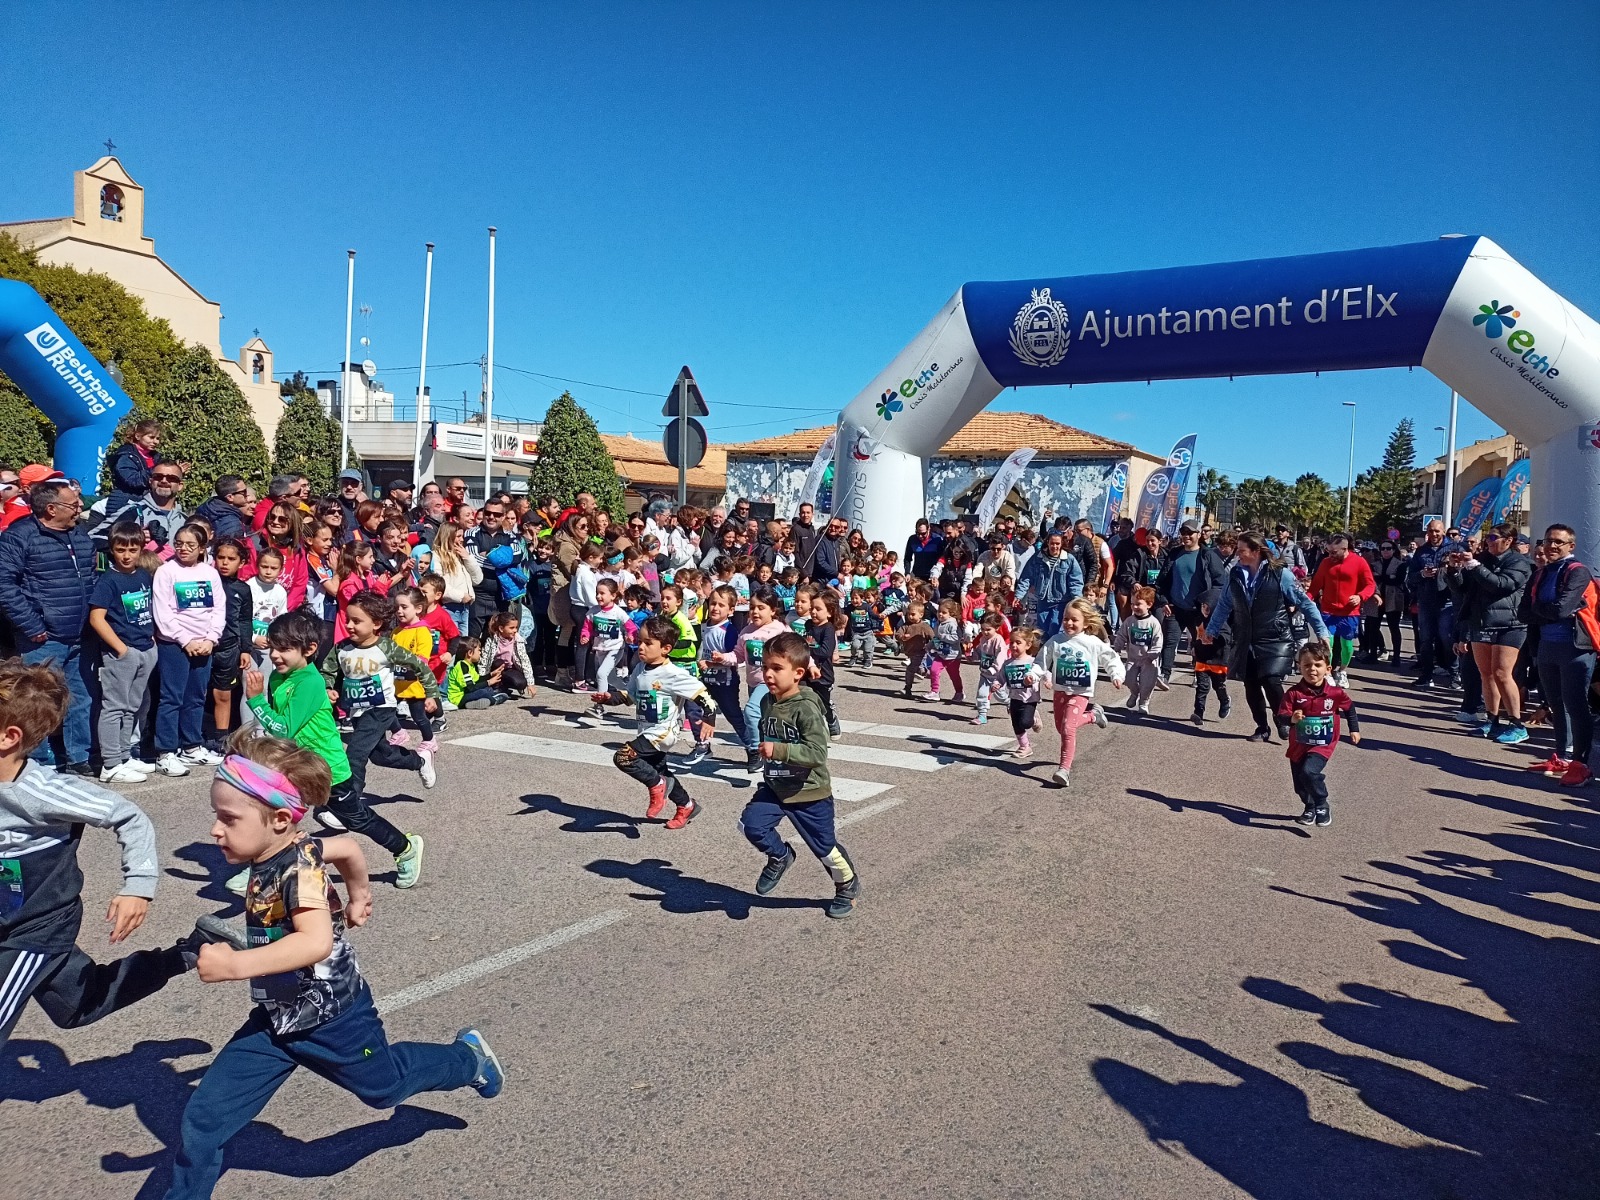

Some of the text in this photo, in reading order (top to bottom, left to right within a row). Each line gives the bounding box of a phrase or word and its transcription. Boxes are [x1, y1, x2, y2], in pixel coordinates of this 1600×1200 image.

[1078, 284, 1399, 347] Ajuntament d'Elx
[60, 345, 117, 408] BeUrban
[46, 354, 107, 416] Running
[185, 588, 206, 599] 998
[133, 597, 149, 610] 997
[597, 622, 614, 632] 907
[1007, 670, 1024, 681] 932
[1060, 666, 1086, 678] 1002
[345, 685, 376, 699] 1023
[1304, 724, 1328, 736] 891
